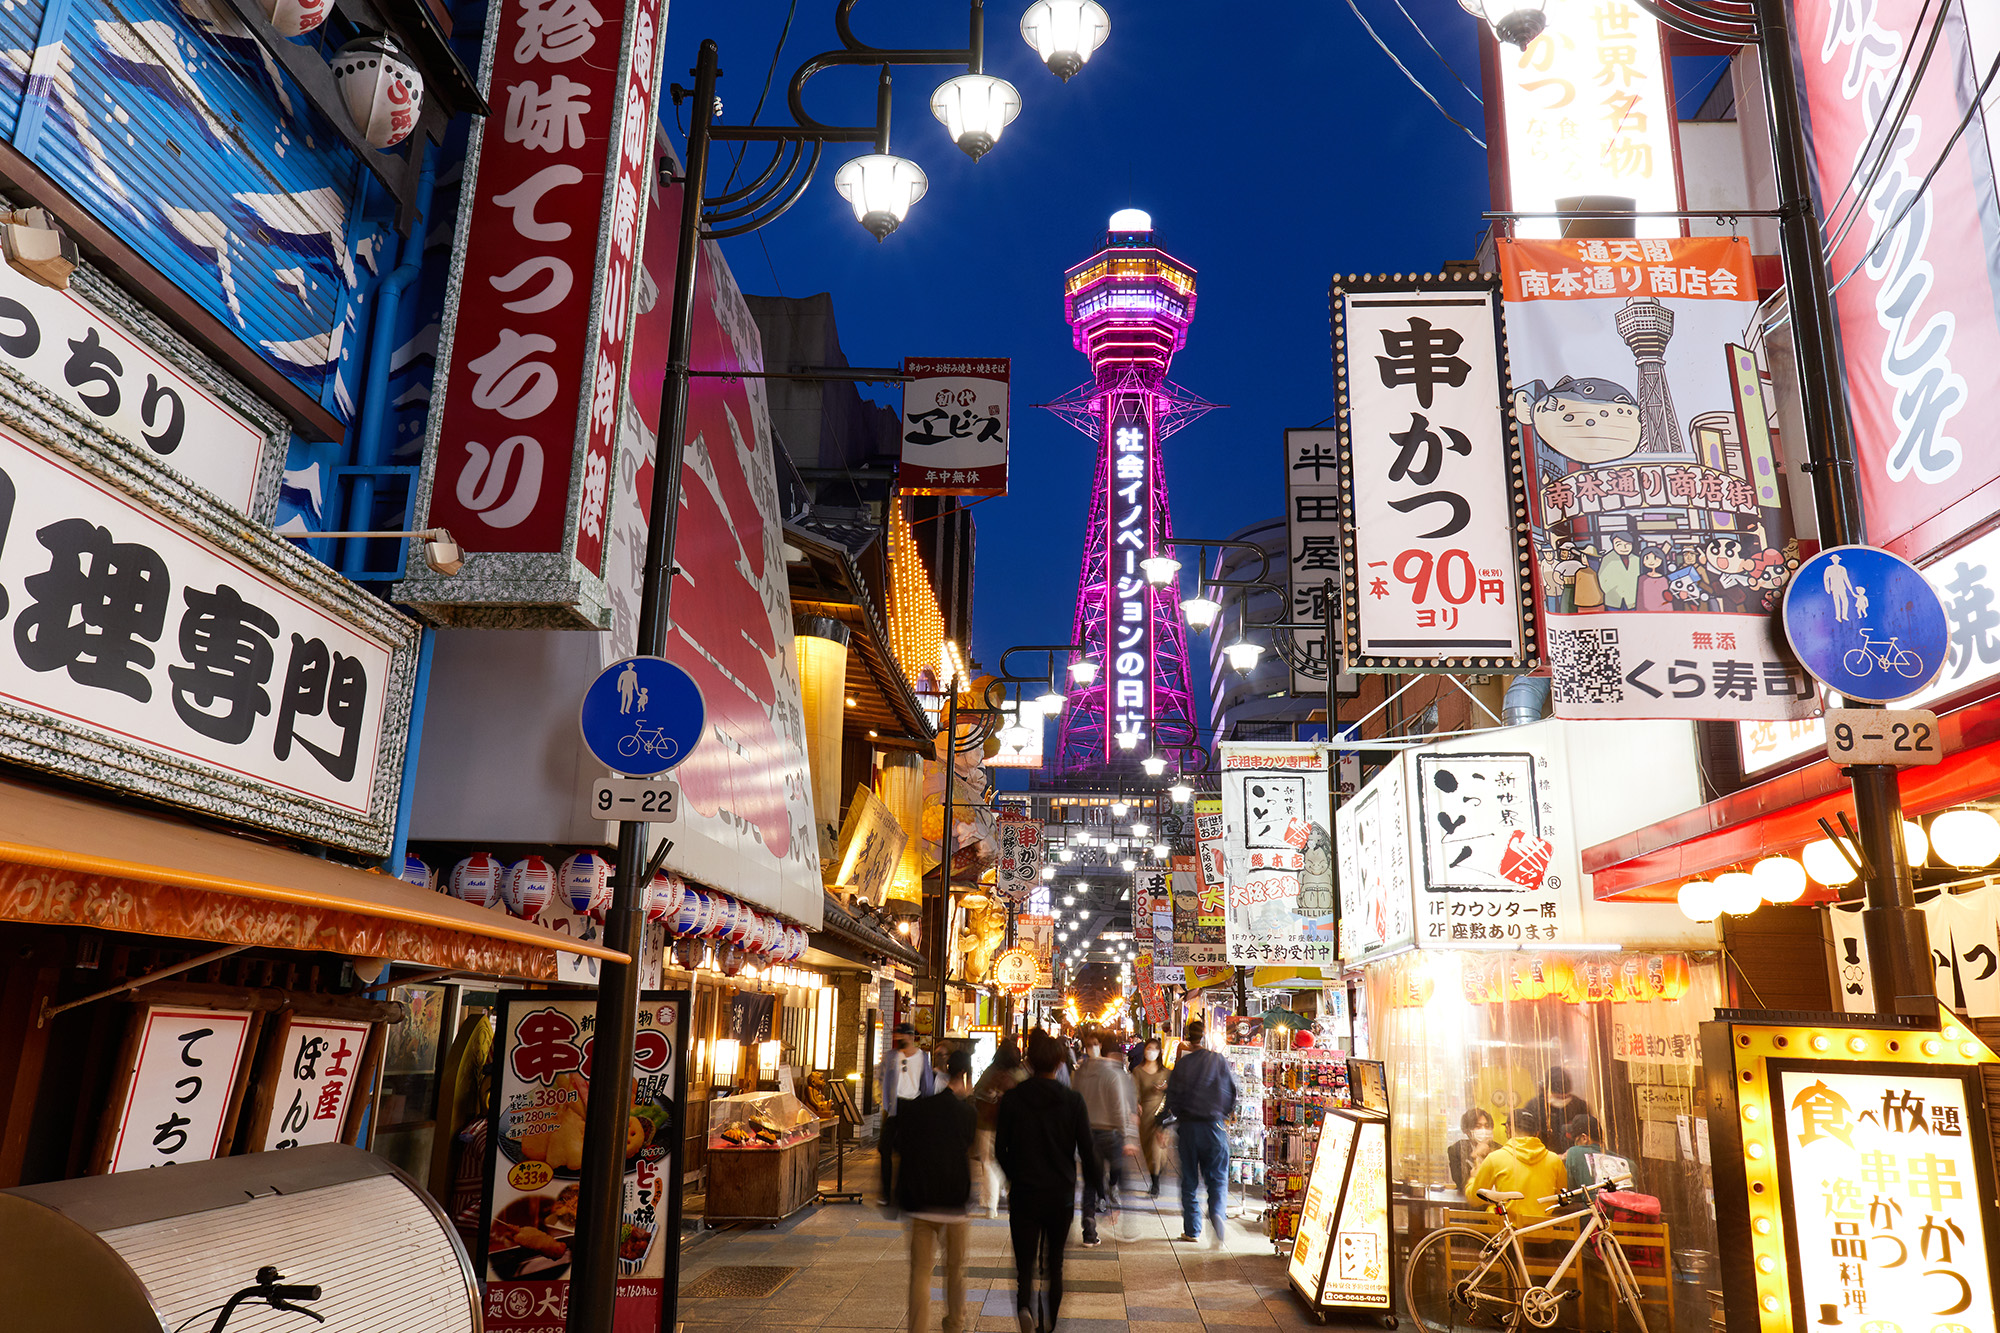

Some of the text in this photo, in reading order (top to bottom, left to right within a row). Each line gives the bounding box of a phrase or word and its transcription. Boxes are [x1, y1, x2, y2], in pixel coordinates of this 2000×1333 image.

[1576, 239, 1674, 263] 通天閣
[1518, 265, 1739, 298] 南本通り商店会
[1376, 317, 1472, 540] 串かつ
[924, 470, 980, 484] 年中無休
[1546, 468, 1754, 509] 南本通り商店街
[1392, 548, 1477, 605] 90
[1416, 607, 1459, 631] ヨリ
[1692, 631, 1737, 650] 無添
[1624, 659, 1814, 701] くら寿司
[1226, 754, 1323, 769] 元祖串カツ専門店
[1200, 828, 1223, 839] おみ
[1017, 826, 1040, 881] 串かつ
[1200, 842, 1214, 883] 大阪名物
[1251, 853, 1304, 868] 総本店
[467, 879, 487, 888] Asahi
[511, 868, 524, 905] アサヒビール
[526, 883, 546, 892] Asahi
[572, 876, 592, 884] Asahi
[1229, 875, 1301, 908] 大阪名物
[1428, 901, 1557, 919] 1F カウンター席
[1428, 922, 1559, 941] 2F 座敷あります
[1189, 951, 1227, 963] くら寿司
[1231, 943, 1330, 961] 宴会予約受付中
[1624, 961, 1642, 997] ビール
[1647, 957, 1664, 994] 串カツ
[313, 1036, 352, 1120] 土産
[150, 1027, 215, 1168] てっち
[534, 1088, 578, 1107] 380円
[1791, 1078, 1962, 1150] 食べ放題
[1860, 1148, 1908, 1269] 串かつ
[1820, 1176, 1870, 1316] 逸品料理
[1907, 1152, 1973, 1316] 串かつ
[487, 1288, 504, 1318] 酒処
